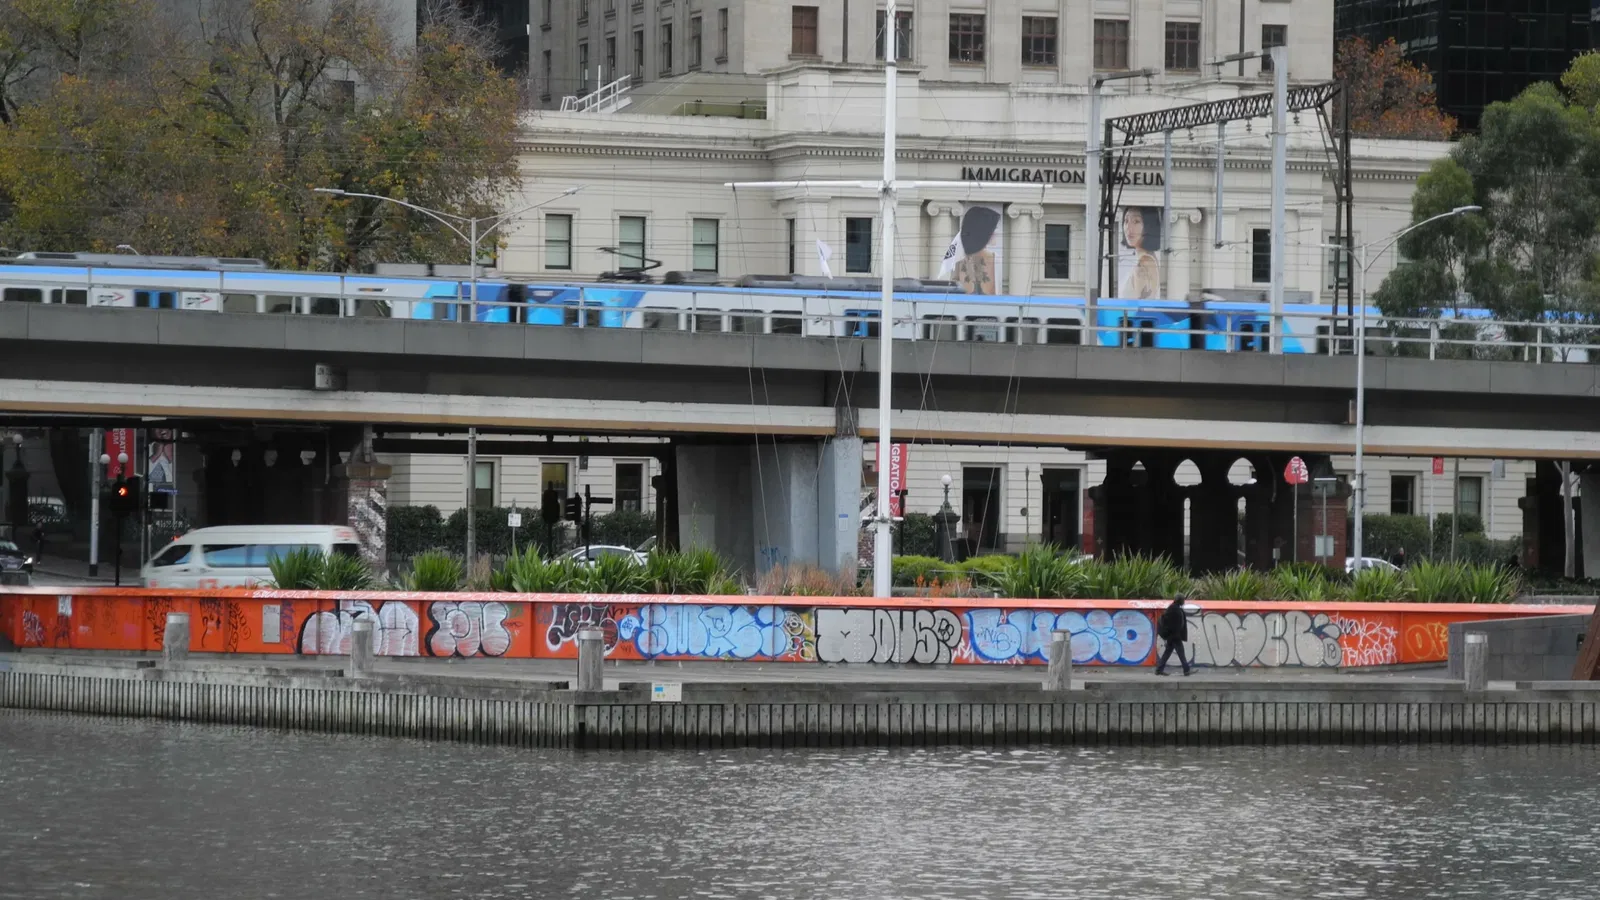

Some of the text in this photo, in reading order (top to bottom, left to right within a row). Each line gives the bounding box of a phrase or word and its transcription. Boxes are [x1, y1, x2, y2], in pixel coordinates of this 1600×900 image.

[961, 167, 1165, 186] IMMIGRATION USEUM
[890, 443, 900, 498] IGRATION
